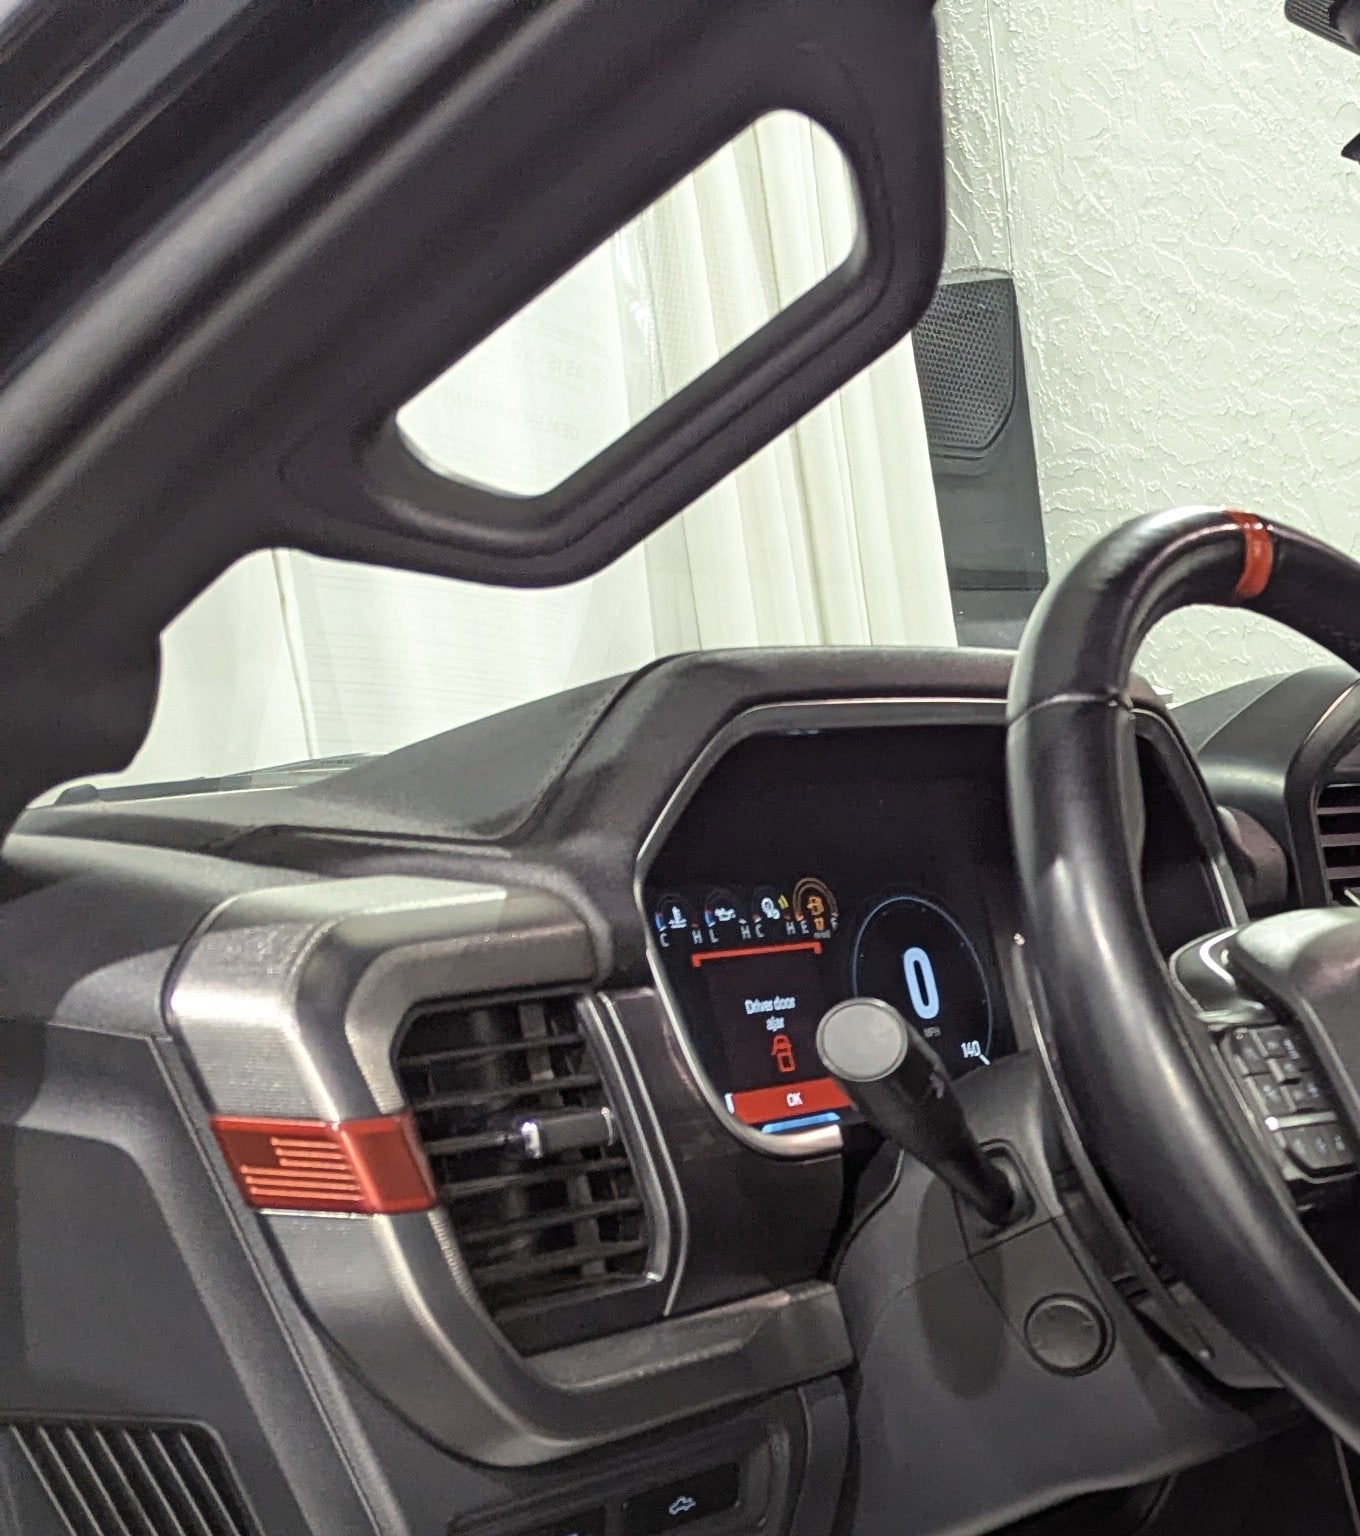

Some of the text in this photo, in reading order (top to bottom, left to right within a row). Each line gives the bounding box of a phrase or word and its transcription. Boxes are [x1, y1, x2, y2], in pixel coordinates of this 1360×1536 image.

[903, 946, 940, 1020] 0
[744, 995, 796, 1015] Driver door
[766, 1015, 785, 1032] ajar
[961, 1040, 982, 1058] 140
[786, 1091, 804, 1107] OK
